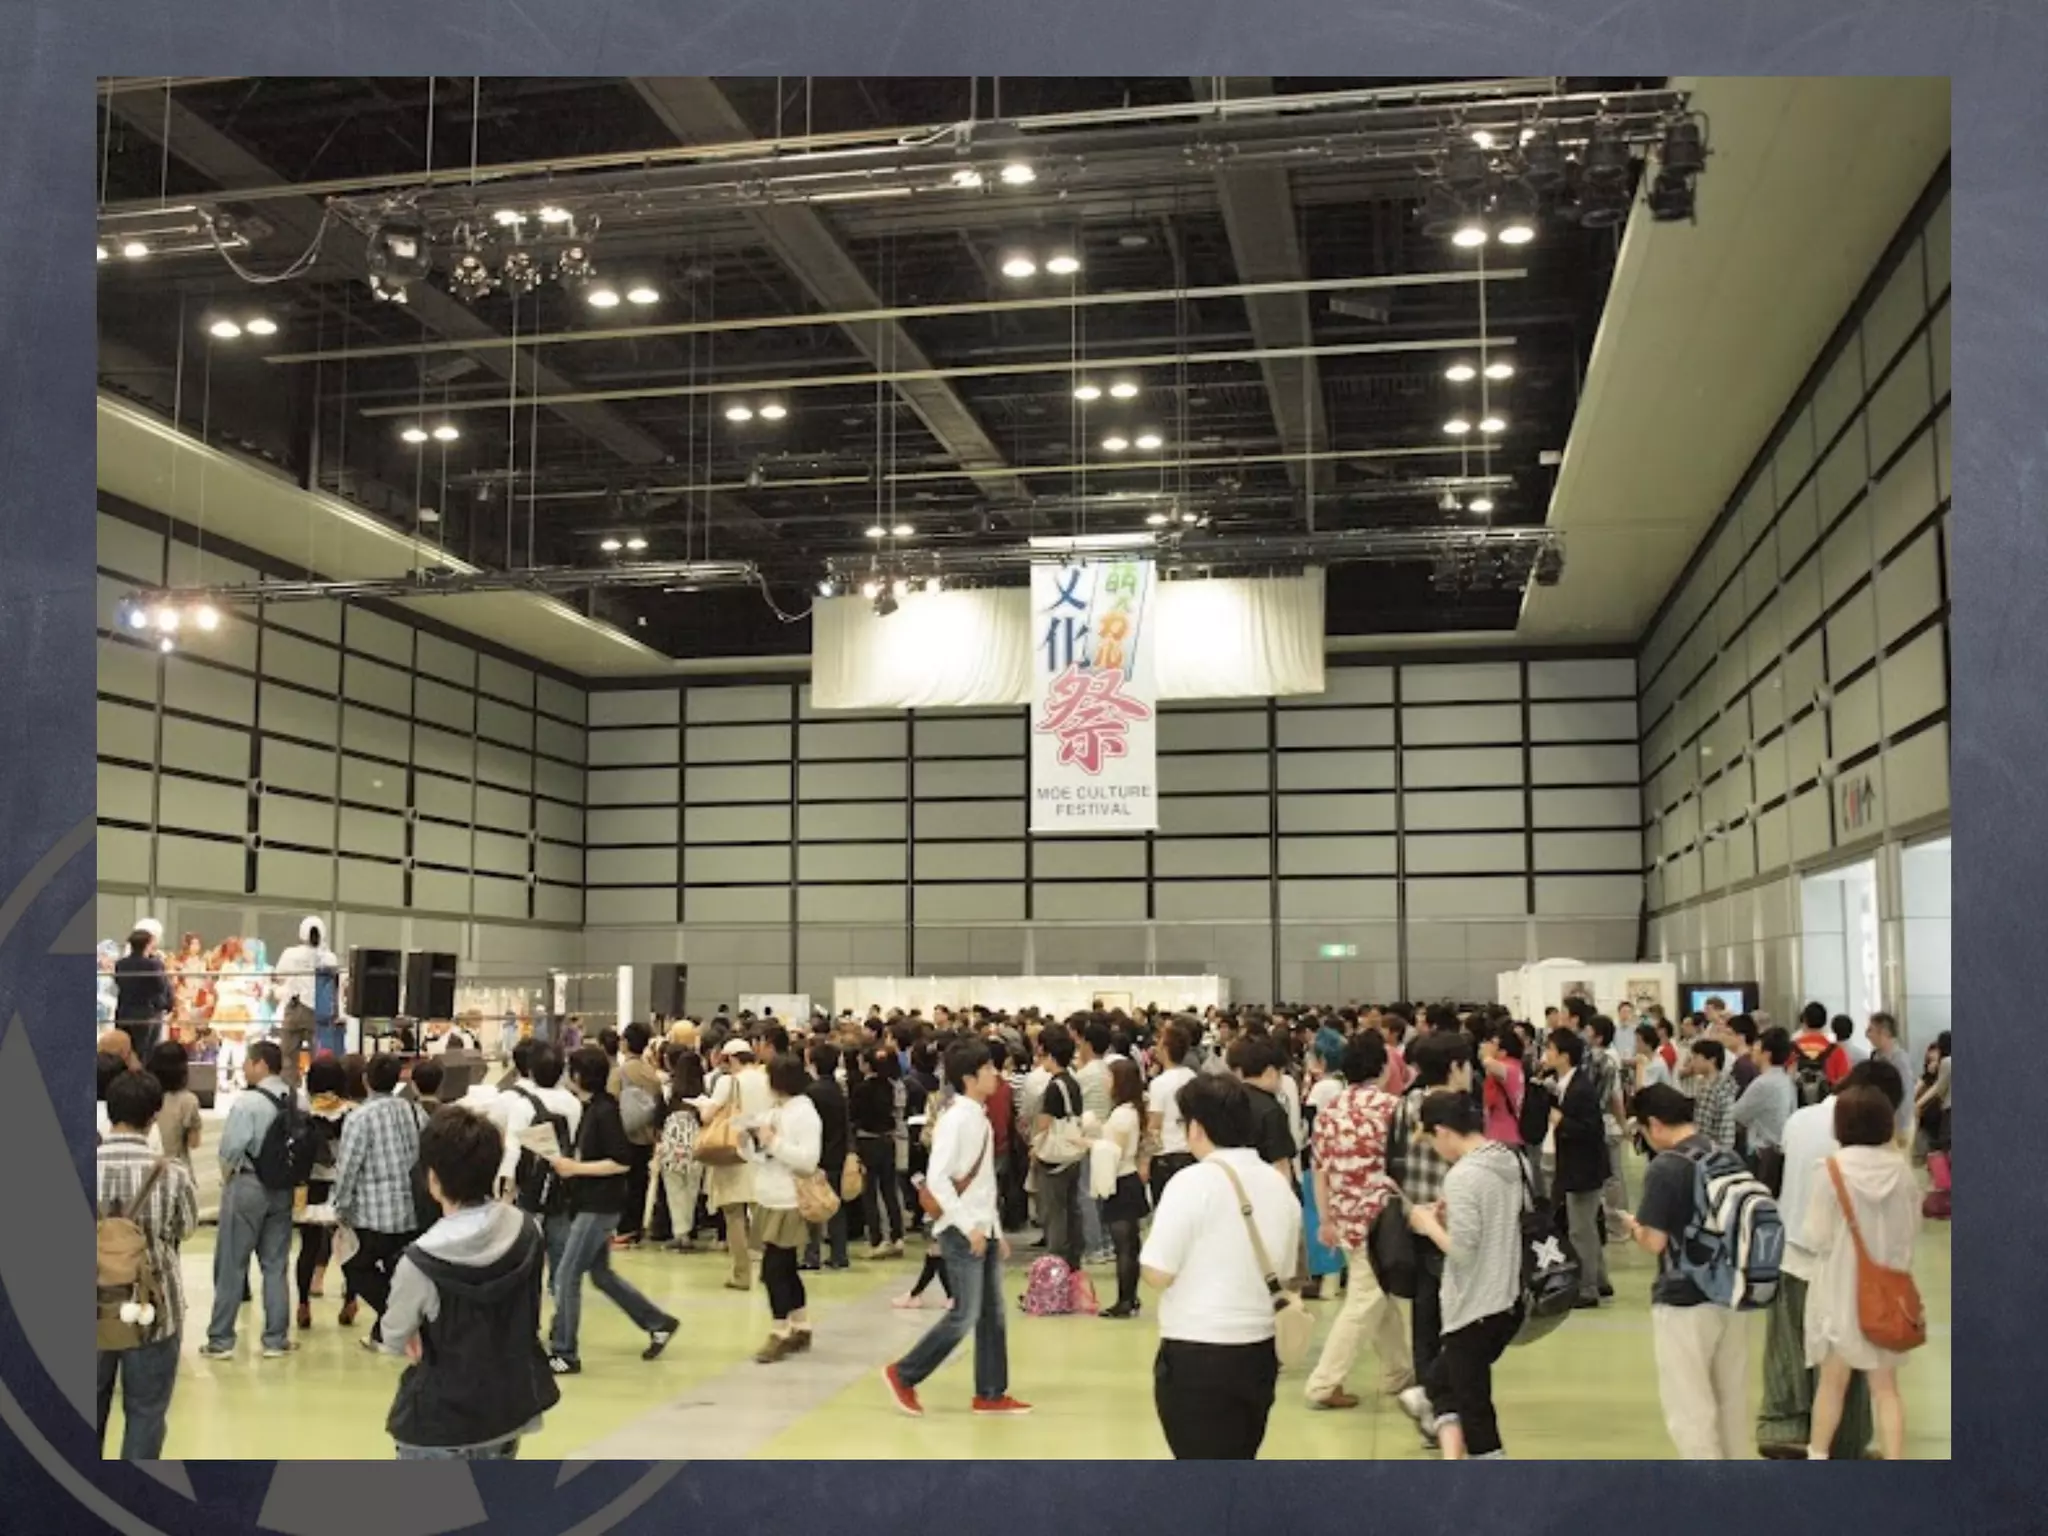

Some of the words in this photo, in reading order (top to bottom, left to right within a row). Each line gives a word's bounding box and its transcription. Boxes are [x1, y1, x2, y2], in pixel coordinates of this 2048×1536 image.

[1037, 786, 1072, 800] MOE
[1076, 785, 1152, 800] CULTURE
[1056, 802, 1132, 816] FESTIVAL
